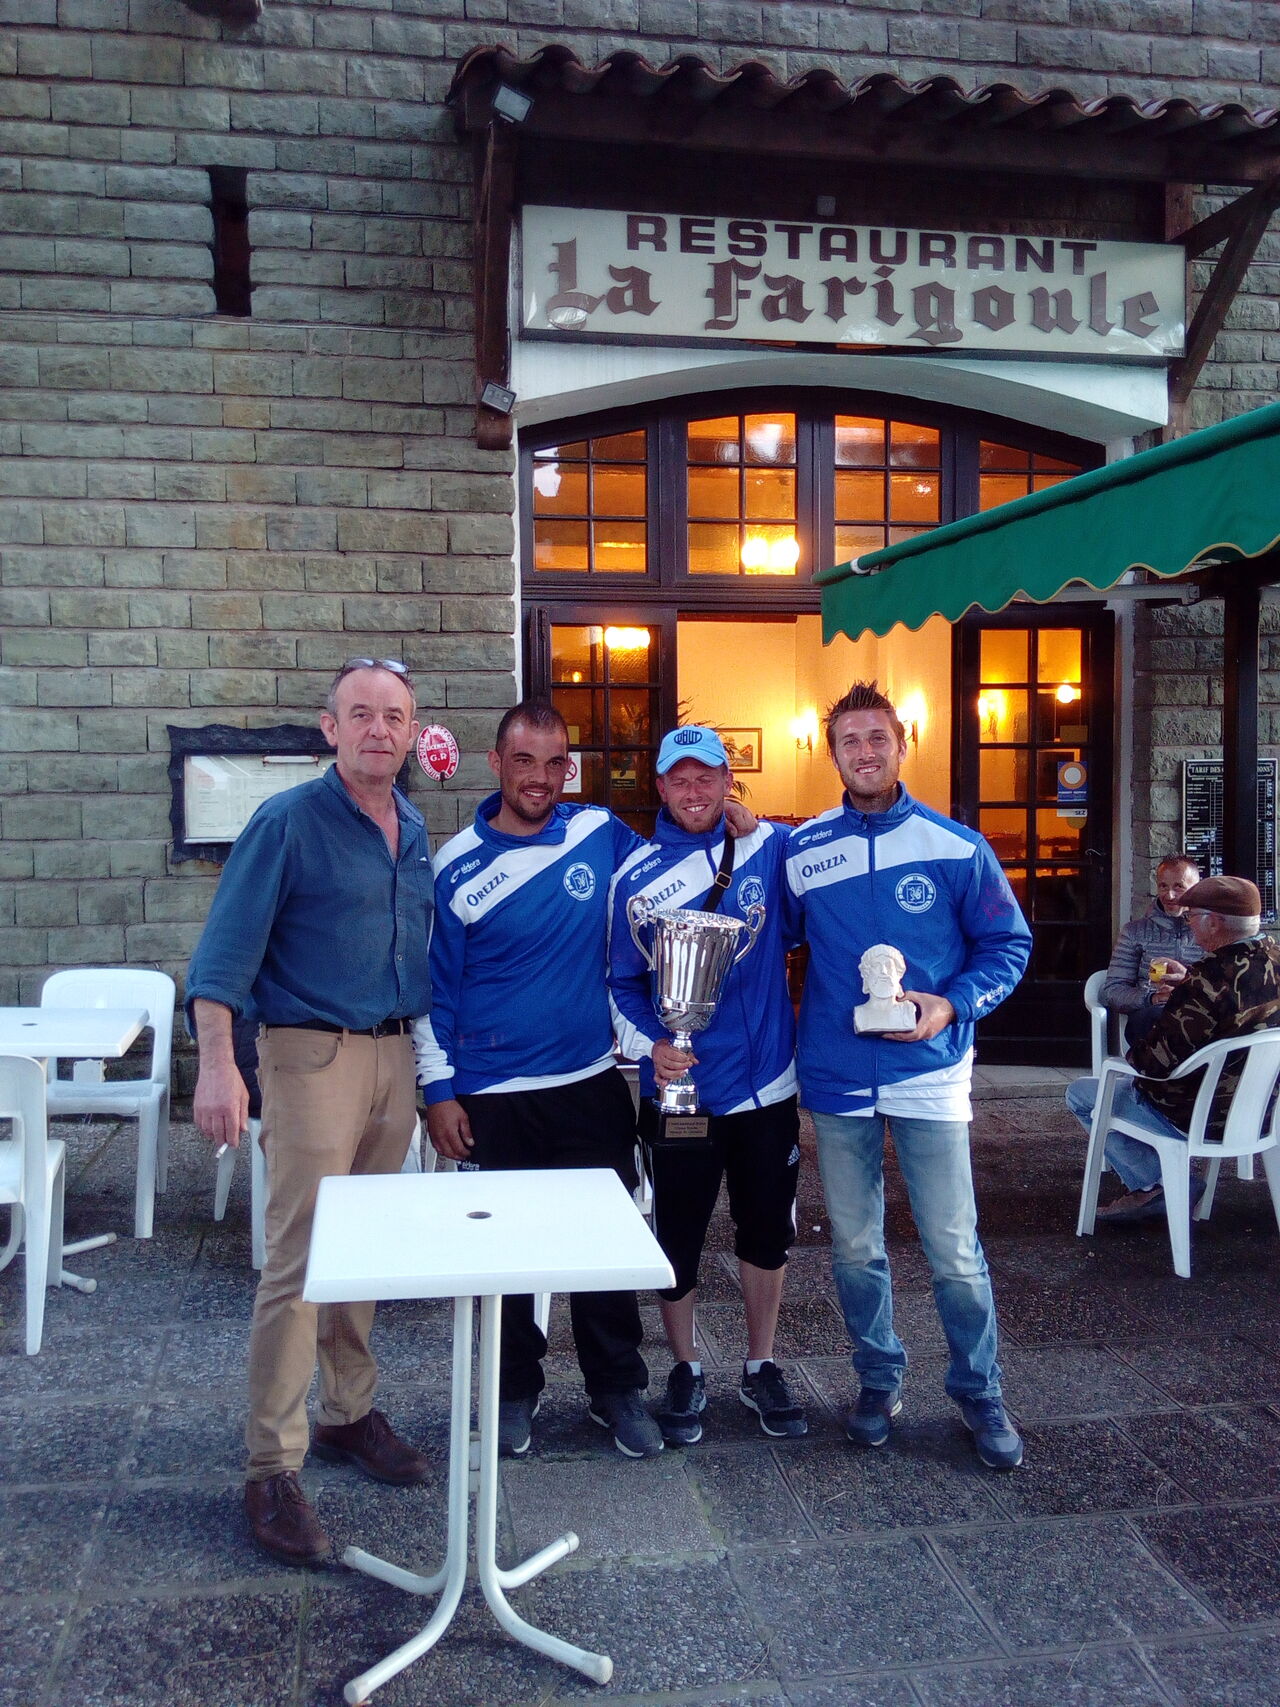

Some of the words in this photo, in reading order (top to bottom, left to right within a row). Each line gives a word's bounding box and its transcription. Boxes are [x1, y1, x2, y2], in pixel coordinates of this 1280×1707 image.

[626, 213, 1097, 276] RESTAURANT
[546, 237, 661, 331] La
[705, 257, 1160, 345] Farigoule
[1191, 766, 1209, 774] TARIF
[1210, 766, 1221, 774] DES
[801, 853, 848, 878] OREZZA
[466, 871, 510, 907] OREZZA
